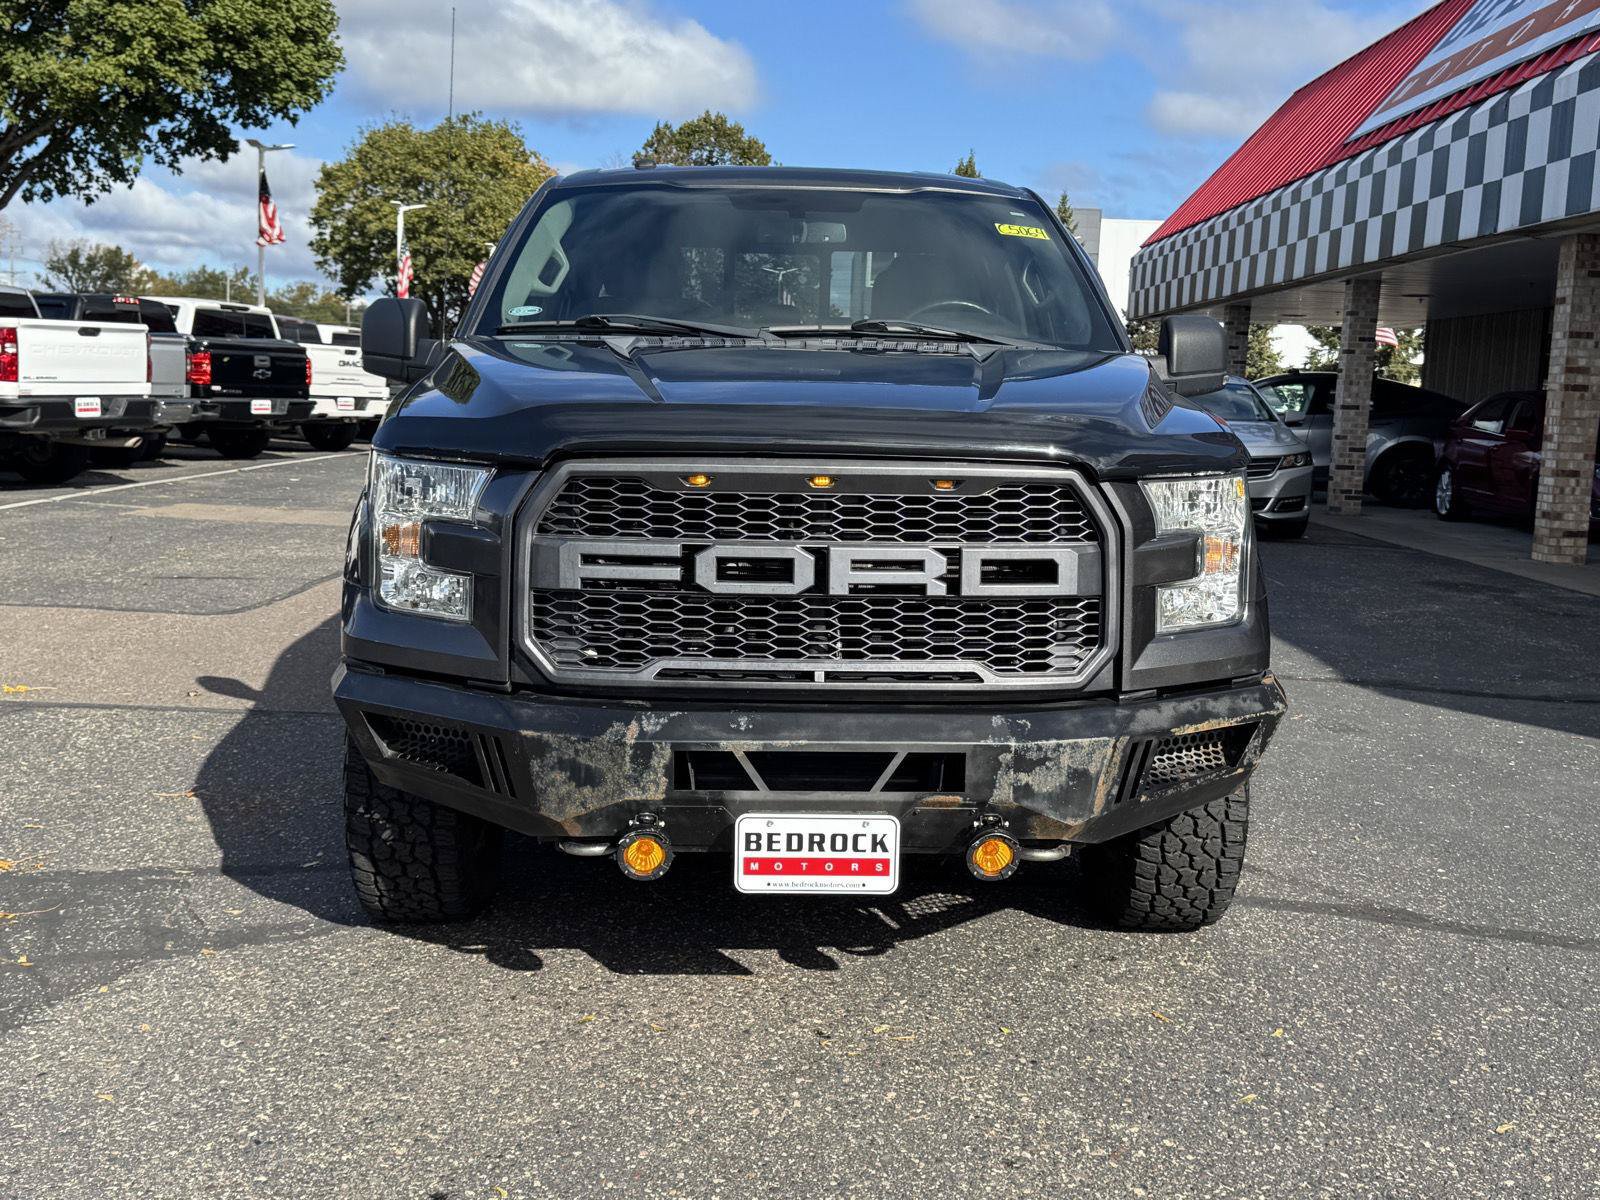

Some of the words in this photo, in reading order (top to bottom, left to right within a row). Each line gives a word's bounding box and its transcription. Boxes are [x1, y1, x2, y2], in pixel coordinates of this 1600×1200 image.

[559, 543, 1079, 596] FORD
[744, 832, 890, 853] BEDROCK
[749, 862, 884, 872] MOTORS
